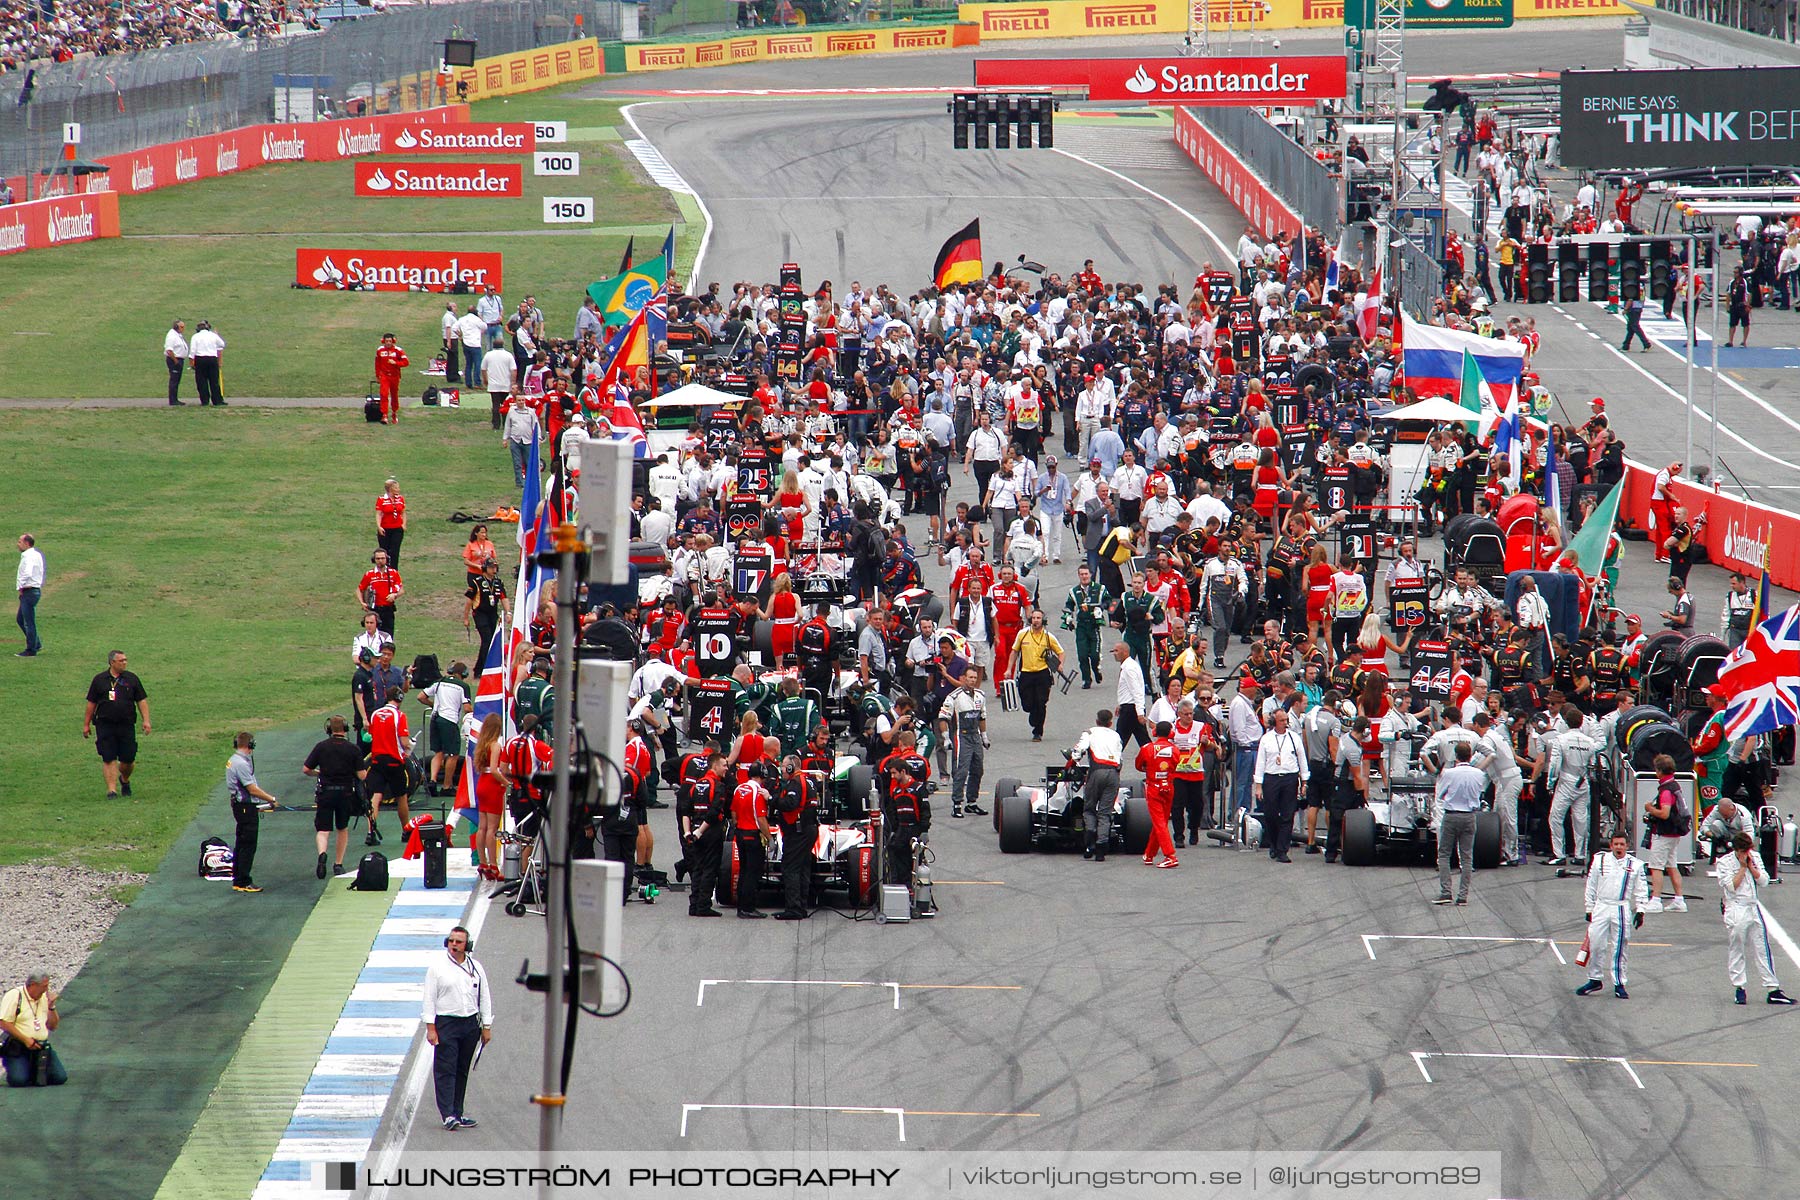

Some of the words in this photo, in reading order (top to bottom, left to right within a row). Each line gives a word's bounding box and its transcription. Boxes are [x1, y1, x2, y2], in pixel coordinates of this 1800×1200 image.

[982, 8, 1049, 32] PIRELLI
[1085, 4, 1156, 28] PIRELLI
[730, 40, 758, 59] PIRELLI
[767, 36, 812, 54] PIRELLI
[827, 34, 876, 52] PIRELLI
[893, 30, 946, 48] PIRELLI
[639, 48, 685, 66] PIRELLI
[696, 44, 722, 62] PIRELLI
[1161, 63, 1309, 92] Santander
[1583, 96, 1636, 112] BERNIE
[1640, 96, 1680, 110] SAYS:
[69, 126, 74, 140] 1
[345, 123, 381, 156] Santander
[420, 128, 524, 148] Santander
[536, 126, 555, 138] 50
[269, 128, 304, 160] Santander
[542, 158, 572, 171] 100
[394, 169, 509, 192] Santander
[55, 200, 93, 241] Santander
[551, 204, 586, 218] 150
[347, 258, 487, 286] Santander
[1210, 286, 1232, 302] 77
[777, 359, 798, 378] 14
[1266, 372, 1292, 390] 26
[1278, 404, 1298, 424] 11
[710, 428, 736, 448] 22
[1290, 442, 1306, 464] 7
[740, 468, 768, 490] 25
[1328, 486, 1346, 510] 8
[728, 514, 760, 536] 99
[1346, 534, 1372, 558] 21
[1732, 520, 1767, 568] Santander
[738, 568, 767, 594] 17
[1396, 600, 1426, 626] 13
[700, 633, 731, 660] 10
[1411, 666, 1451, 694] 44
[700, 706, 723, 734] 4
